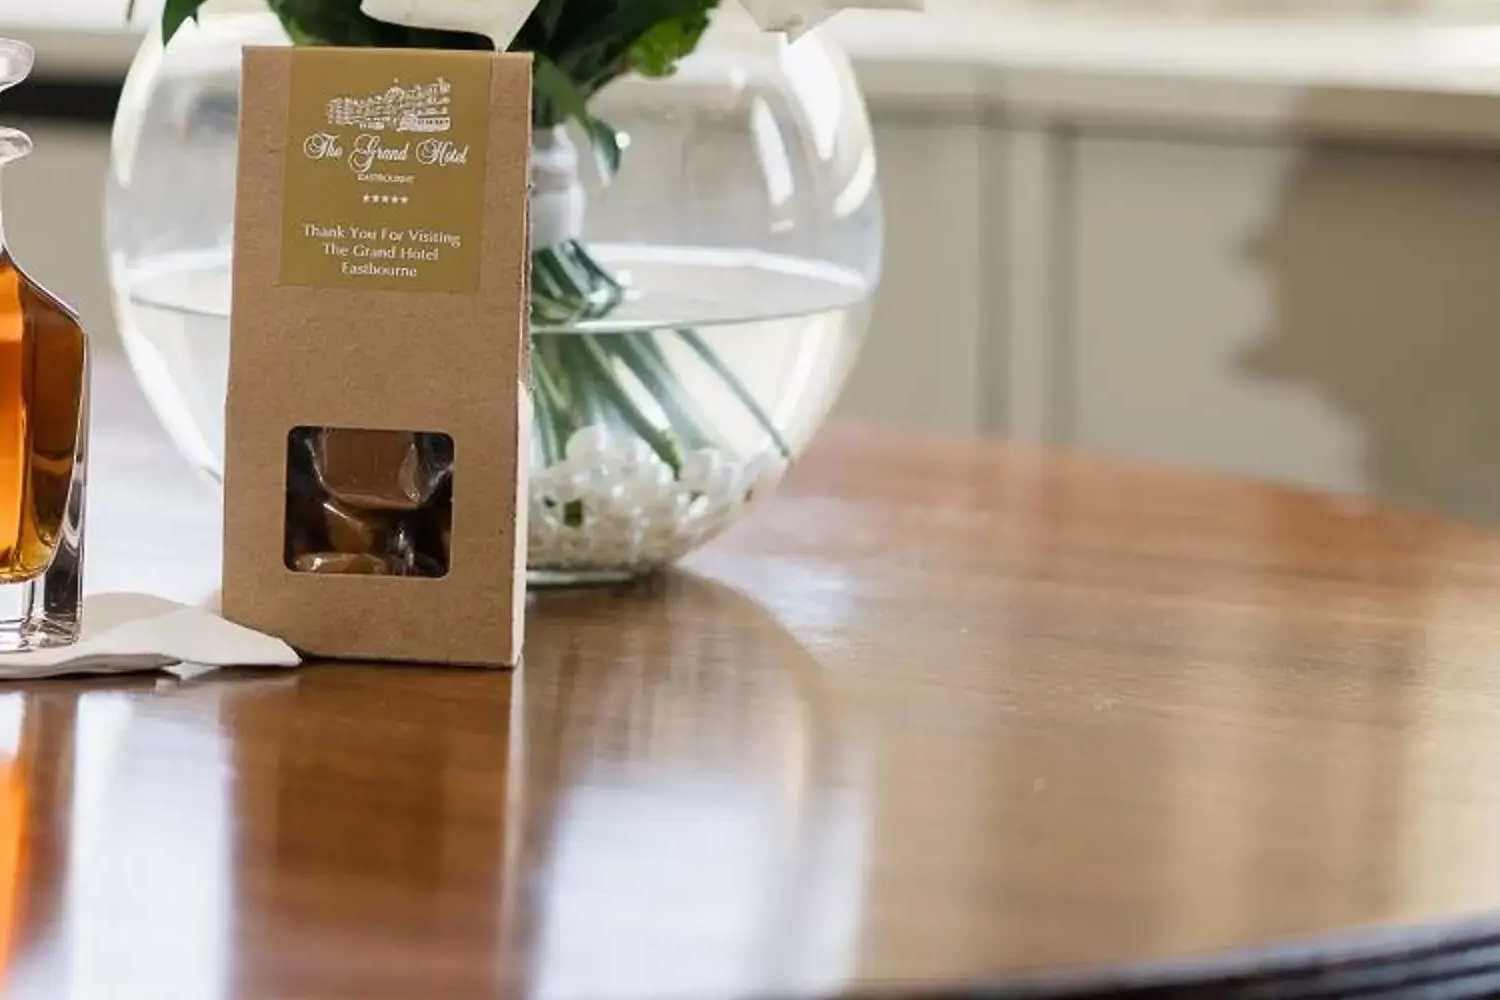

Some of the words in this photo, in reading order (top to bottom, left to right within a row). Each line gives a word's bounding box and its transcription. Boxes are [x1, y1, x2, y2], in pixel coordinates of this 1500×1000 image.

[303, 133, 343, 159] The
[348, 133, 409, 172] Grand
[416, 138, 469, 166] Hotel
[303, 224, 345, 238] Thank
[349, 227, 376, 240] You
[381, 228, 403, 241] For
[408, 229, 461, 248] Visiting
[324, 244, 348, 256] The
[353, 245, 395, 259] Grand
[401, 247, 439, 261] Hotel
[341, 262, 417, 277] Eastbourne
